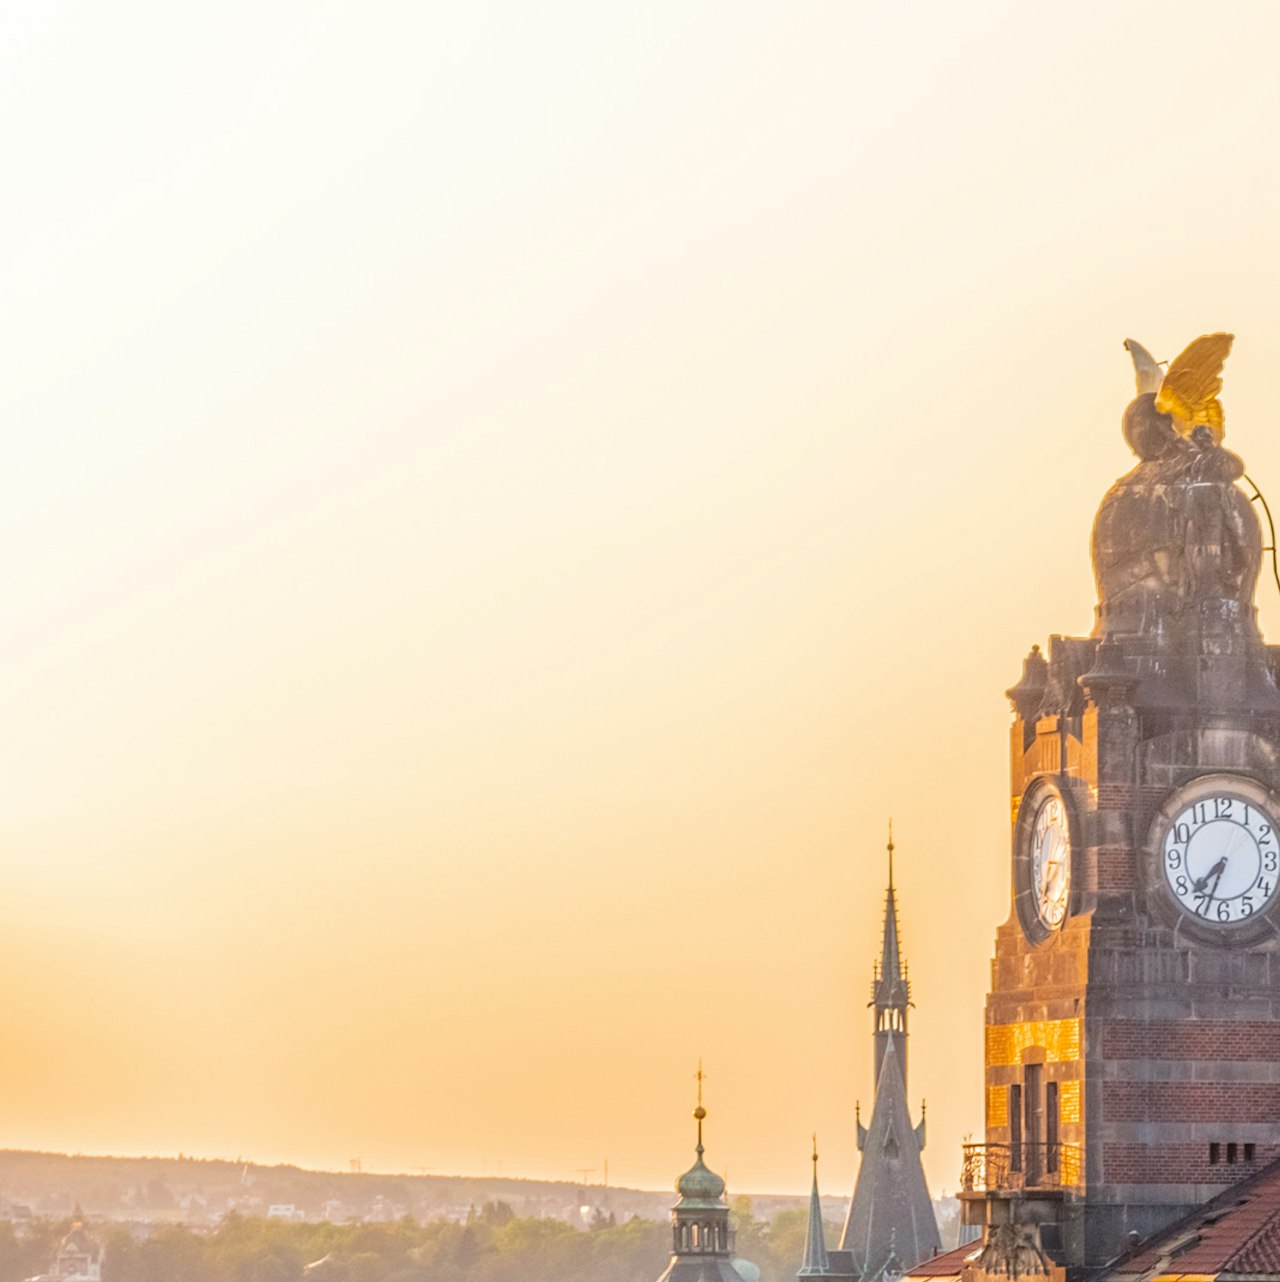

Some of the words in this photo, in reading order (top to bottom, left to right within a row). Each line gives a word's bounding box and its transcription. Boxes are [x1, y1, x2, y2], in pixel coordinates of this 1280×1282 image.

[1192, 803, 1207, 824] 11
[1214, 798, 1232, 819] 12
[1244, 804, 1250, 825] 1
[1173, 823, 1190, 844] 10
[1258, 824, 1271, 845] 2
[1167, 849, 1181, 870] 9
[1264, 851, 1277, 871] 3
[1175, 875, 1188, 896] 8
[1257, 876, 1271, 897] 4
[1193, 895, 1205, 916] 7
[1217, 901, 1229, 922] 6
[1241, 896, 1253, 916] 5
